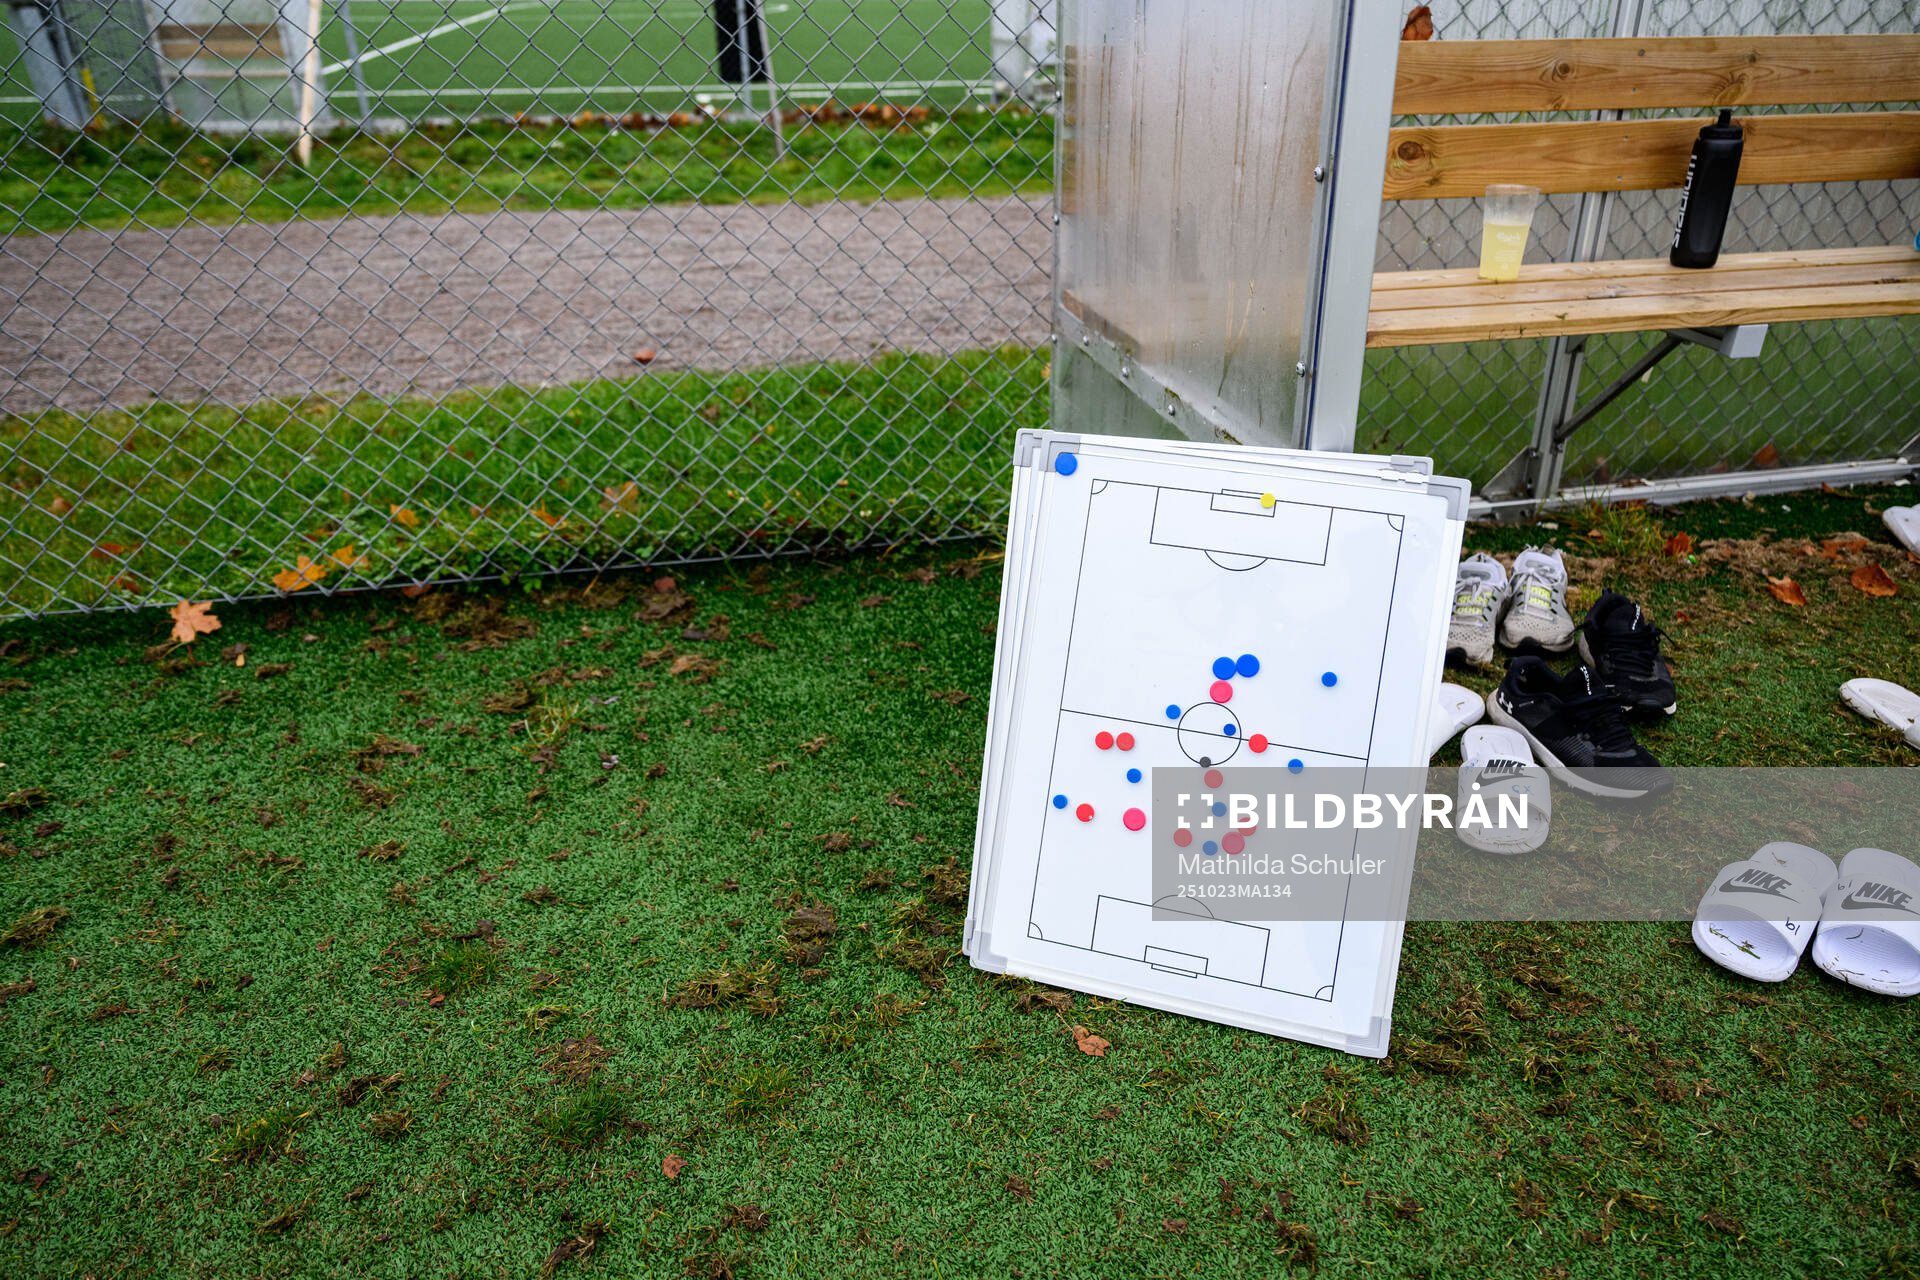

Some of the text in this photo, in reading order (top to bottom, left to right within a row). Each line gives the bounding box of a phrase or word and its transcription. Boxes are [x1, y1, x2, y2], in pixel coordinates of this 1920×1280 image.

[1483, 759, 1527, 776] NIKE
[1733, 868, 1793, 895] NIKE
[1854, 881, 1913, 908] NIKE
